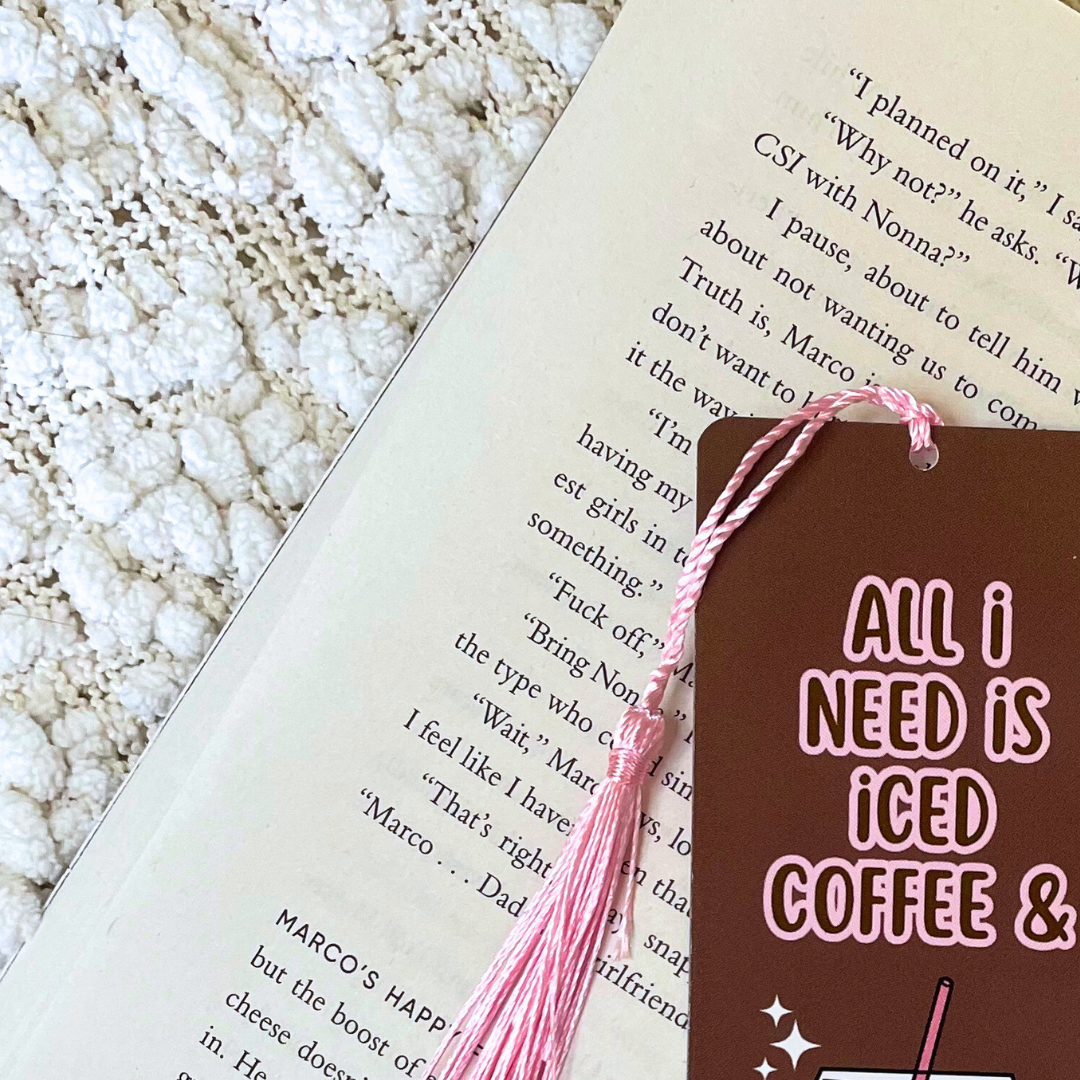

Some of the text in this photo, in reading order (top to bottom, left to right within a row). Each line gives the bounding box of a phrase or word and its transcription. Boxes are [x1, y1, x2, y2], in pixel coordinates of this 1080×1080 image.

[848, 66, 874, 101] “I
[865, 92, 971, 161] planned
[969, 155, 1001, 184] on
[1003, 168, 1048, 203] it,”
[1044, 191, 1066, 217] I
[753, 131, 971, 268] CSI with Nonna?”
[764, 196, 1062, 395] I pause, about to tell him
[526, 511, 664, 599] something.”
[547, 571, 666, 660] “Fuck off,”
[843, 575, 965, 667] ALL
[799, 669, 967, 760] NEED
[274, 907, 380, 991] MARCO’S
[763, 854, 1077, 951] COFFEE &
[249, 943, 428, 1079] but the boost of
